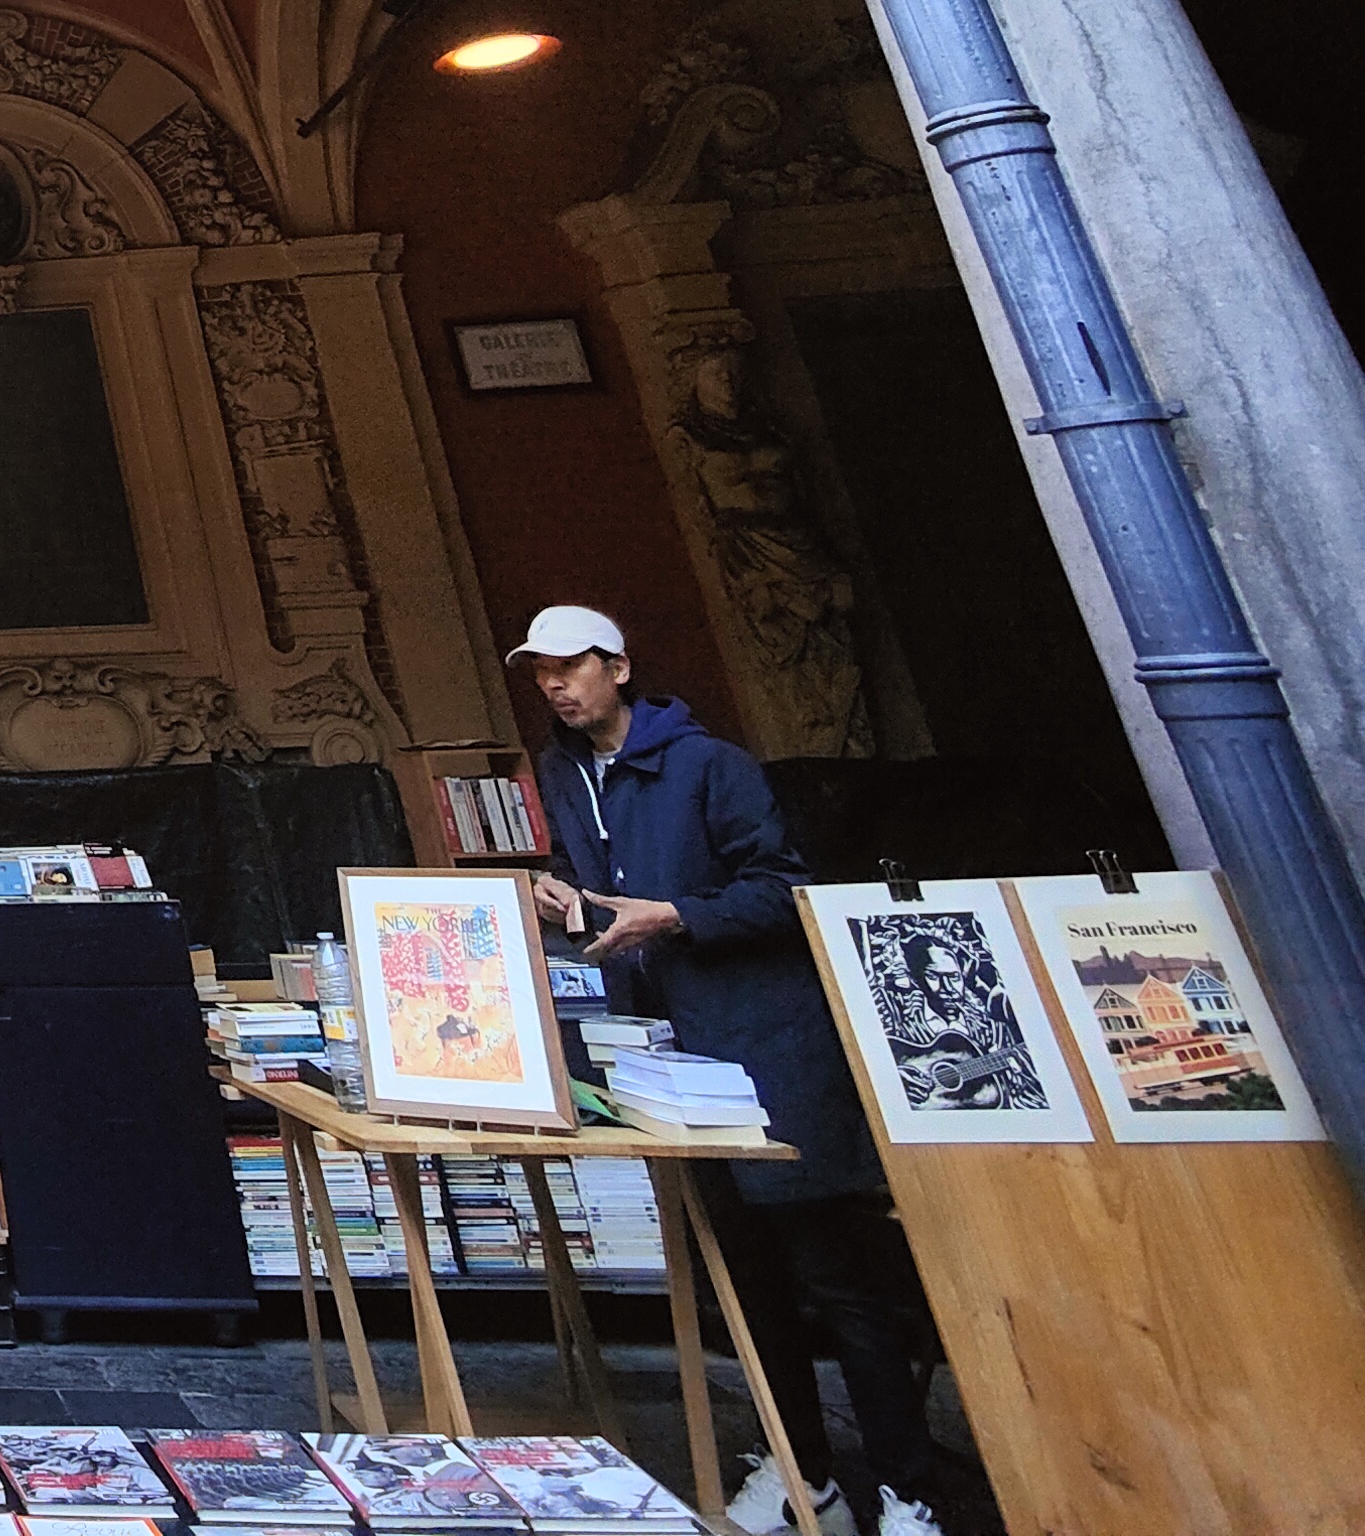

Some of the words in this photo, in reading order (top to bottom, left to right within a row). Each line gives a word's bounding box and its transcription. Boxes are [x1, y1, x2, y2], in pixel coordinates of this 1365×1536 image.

[381, 915, 419, 932] NEW
[422, 916, 492, 934] YORKER
[1067, 920, 1104, 939] San
[1106, 919, 1197, 939] Francisco
